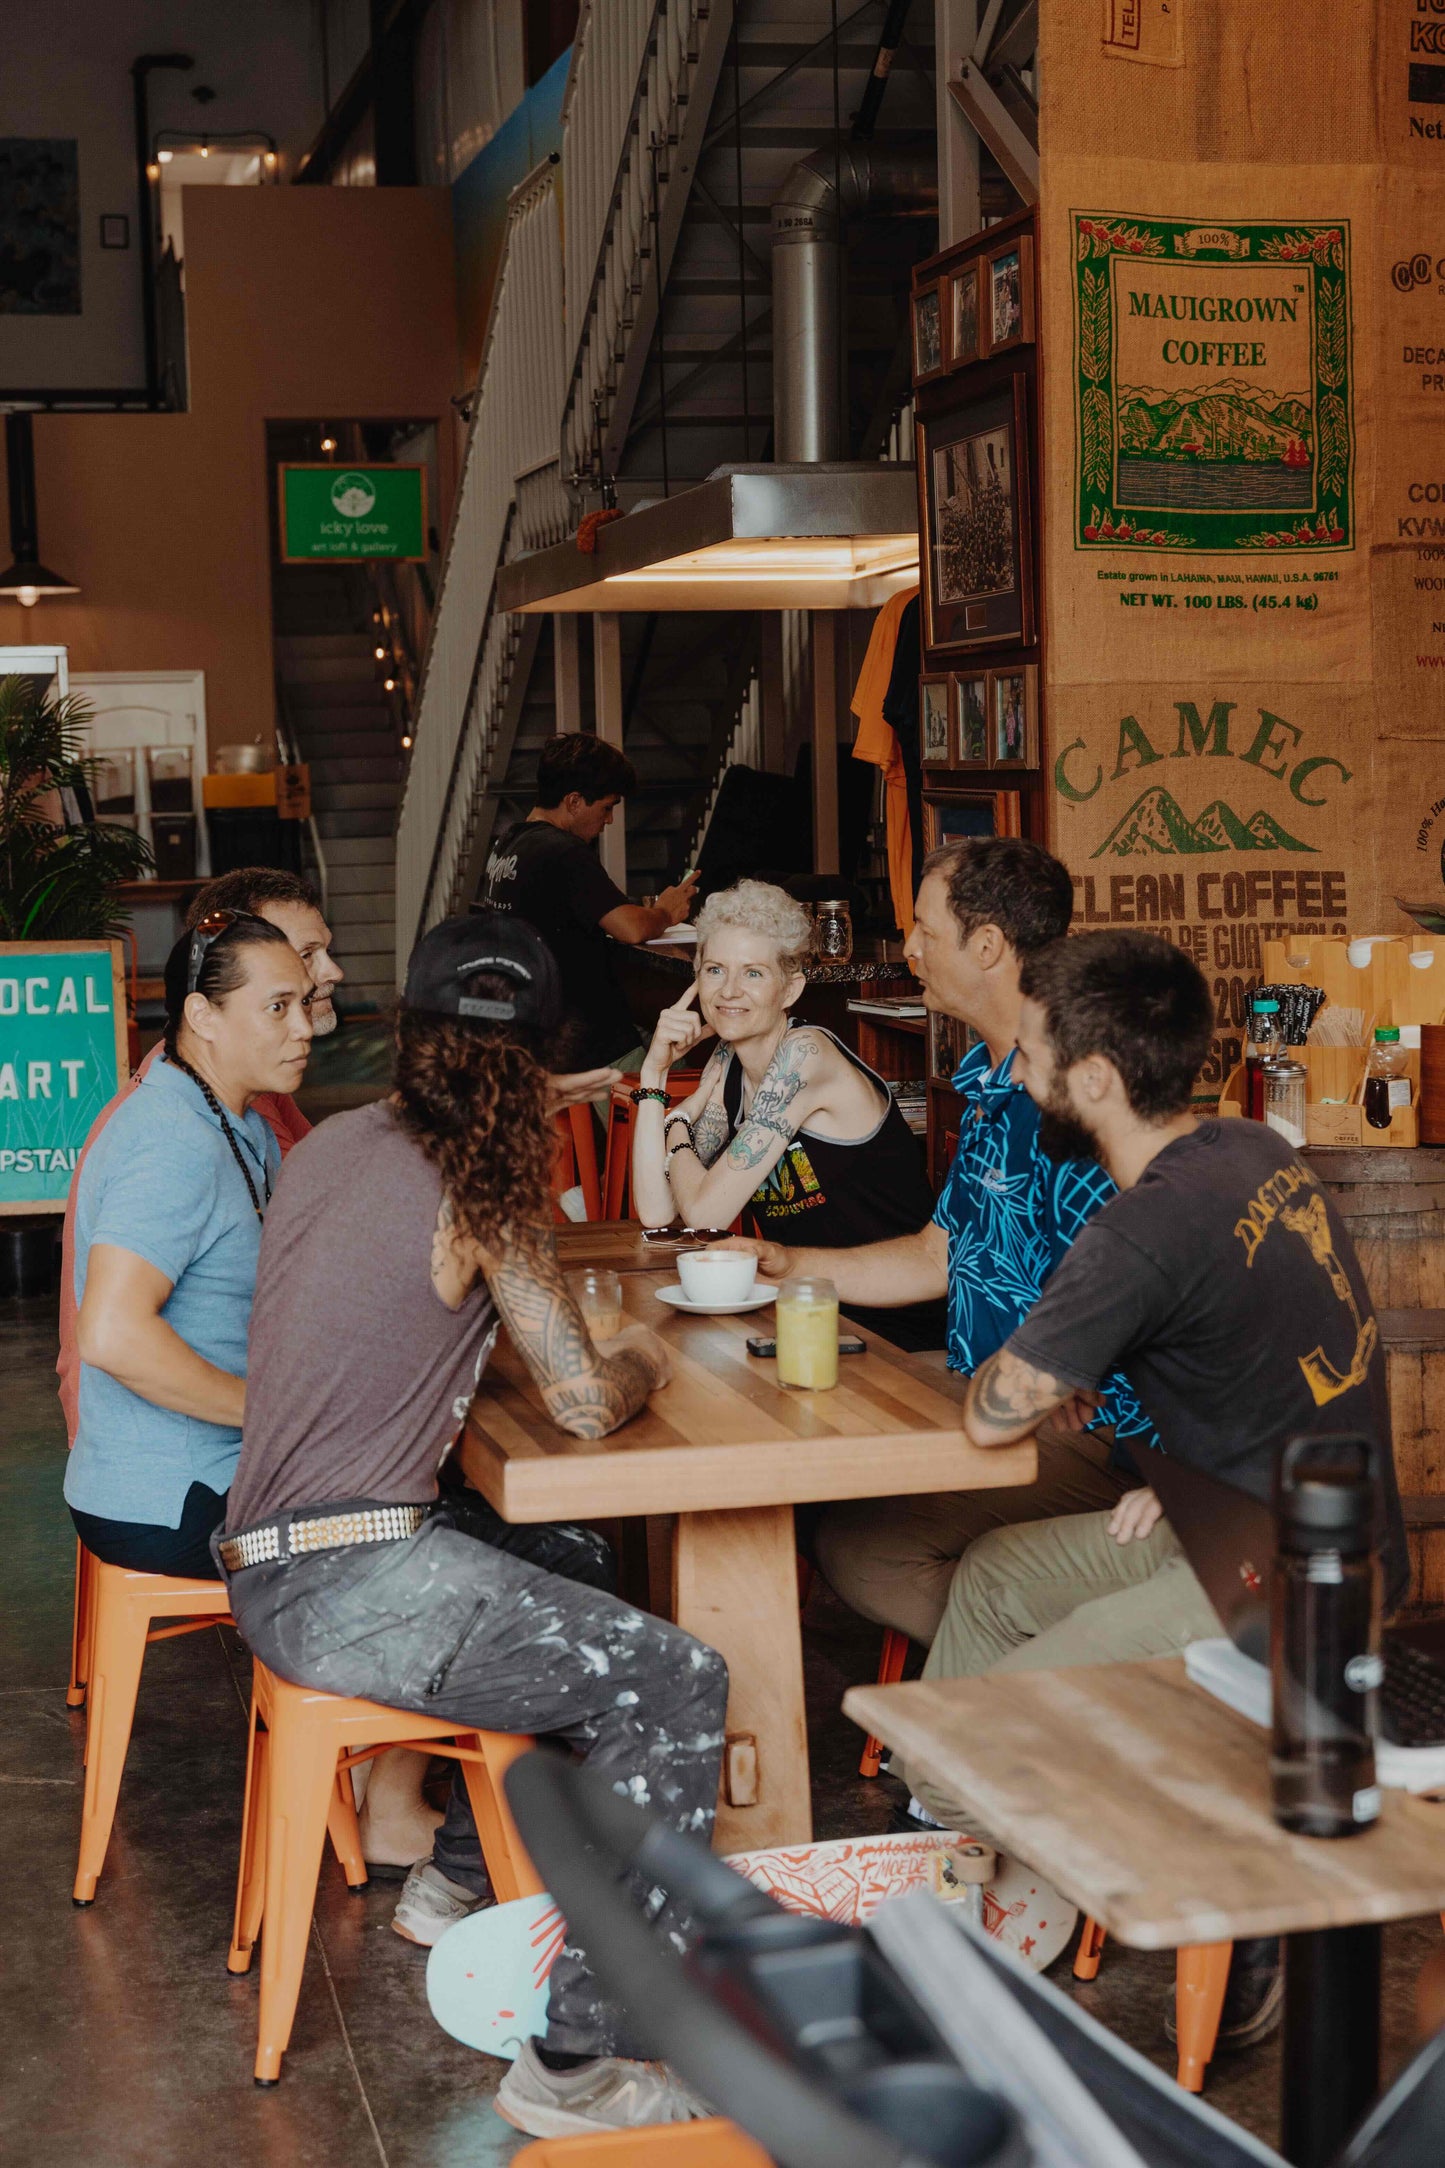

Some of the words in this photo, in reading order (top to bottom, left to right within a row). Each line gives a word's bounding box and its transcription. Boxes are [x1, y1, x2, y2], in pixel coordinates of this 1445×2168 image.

[1198, 233, 1230, 247] 100%
[1128, 291, 1298, 323] MAUIGROWN
[1162, 339, 1267, 366] COFFEE
[320, 521, 353, 537] icky
[355, 521, 389, 534] love
[1097, 570, 1127, 581] Estate
[1129, 572, 1158, 583] grown
[1160, 572, 1169, 582] in
[1216, 574, 1244, 584] MAUI,
[1245, 574, 1282, 584] HAWAII,
[1283, 572, 1311, 582] U.S.A.
[1313, 571, 1339, 581] 96761
[1120, 592, 1148, 607] NET
[1151, 594, 1178, 608] WT.
[1183, 595, 1212, 609] 100
[1217, 595, 1248, 609] LBS.
[1252, 594, 1291, 613] (45.4
[1296, 592, 1319, 611] kg)
[1050, 701, 1353, 806] CAMEC
[1416, 817, 1433, 851] 100%
[1197, 870, 1347, 919] COFFEE
[0, 1060, 85, 1100] ART
